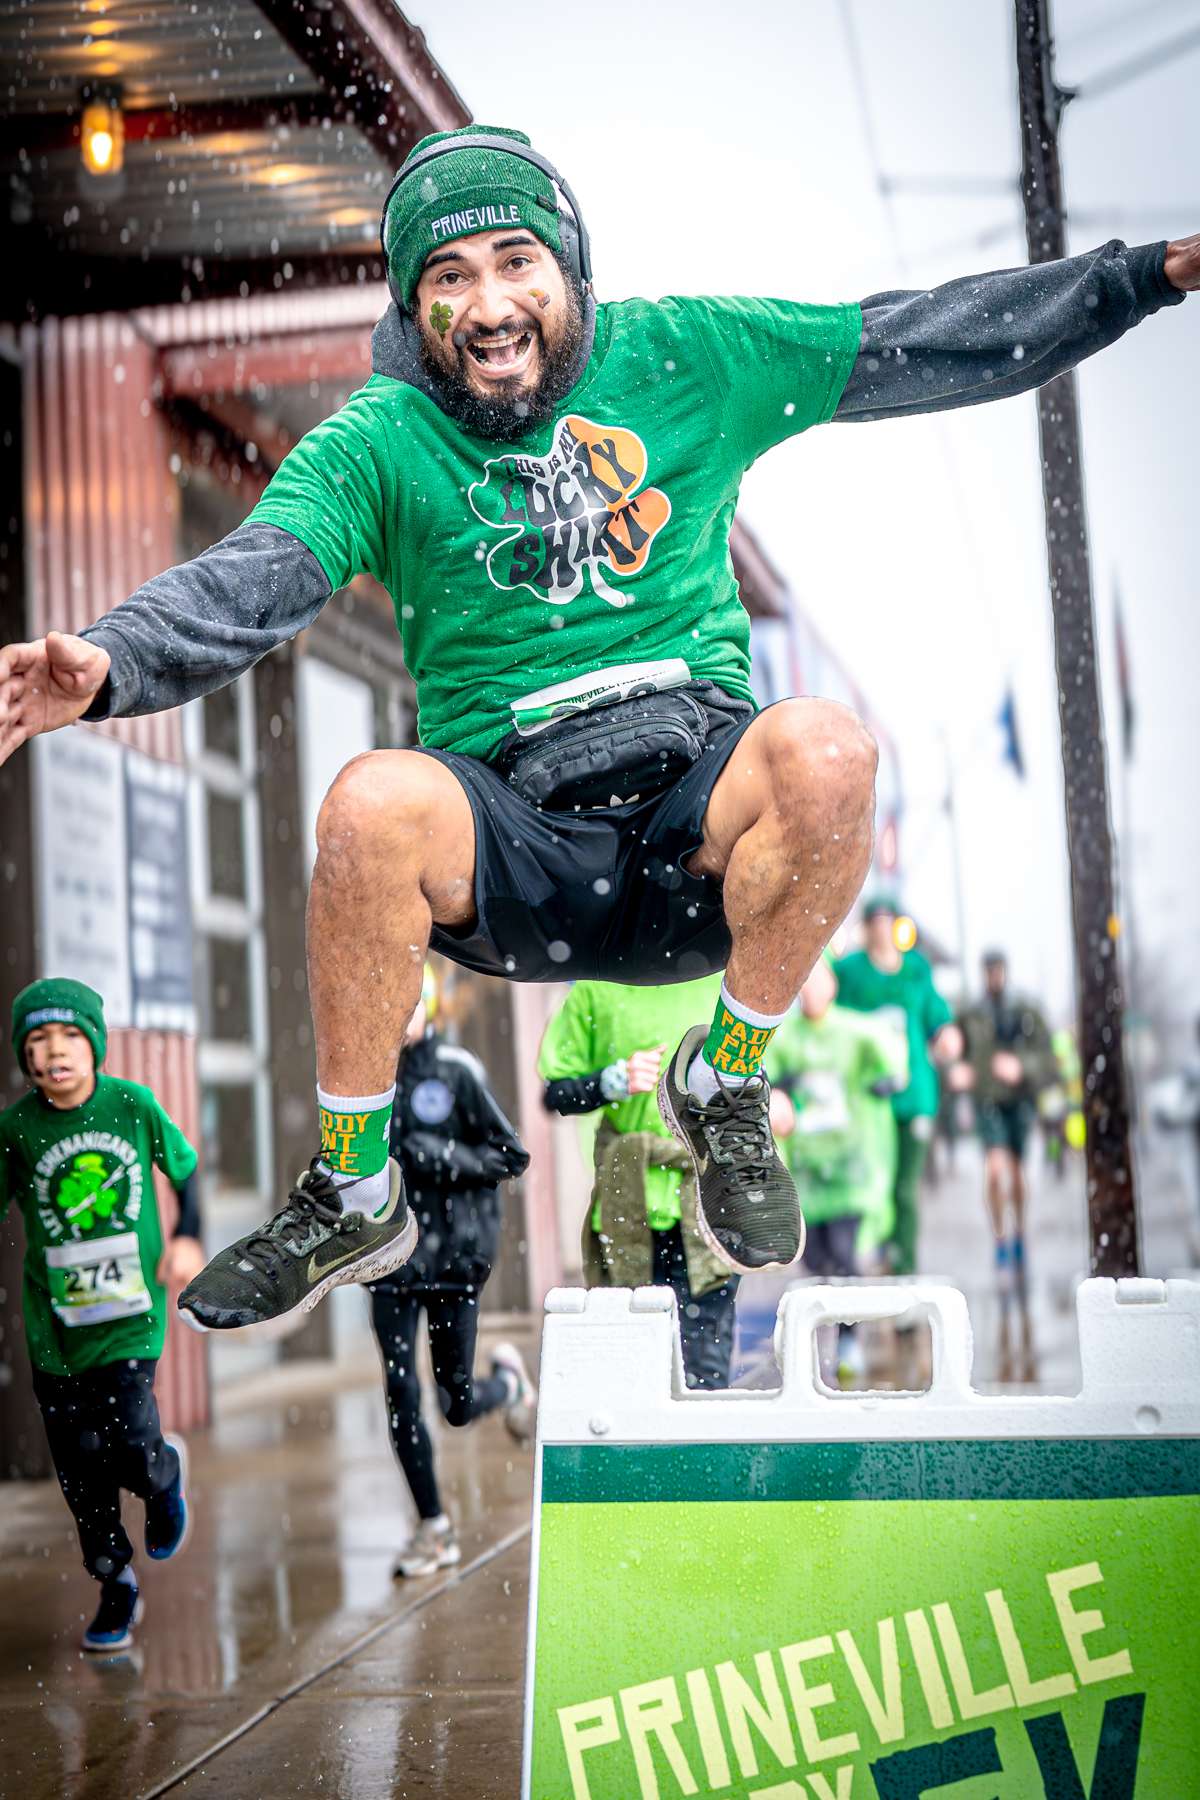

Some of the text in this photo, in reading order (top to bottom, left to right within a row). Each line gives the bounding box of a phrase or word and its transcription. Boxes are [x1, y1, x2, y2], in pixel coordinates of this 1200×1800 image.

[431, 204, 521, 241] PRINEVILLE
[499, 422, 579, 479] THIS IS MY
[501, 438, 637, 528] LUCKY
[508, 499, 650, 589] SHIRT
[64, 1257, 123, 1294] 274
[556, 1561, 1134, 1800] PRINEVILLE
